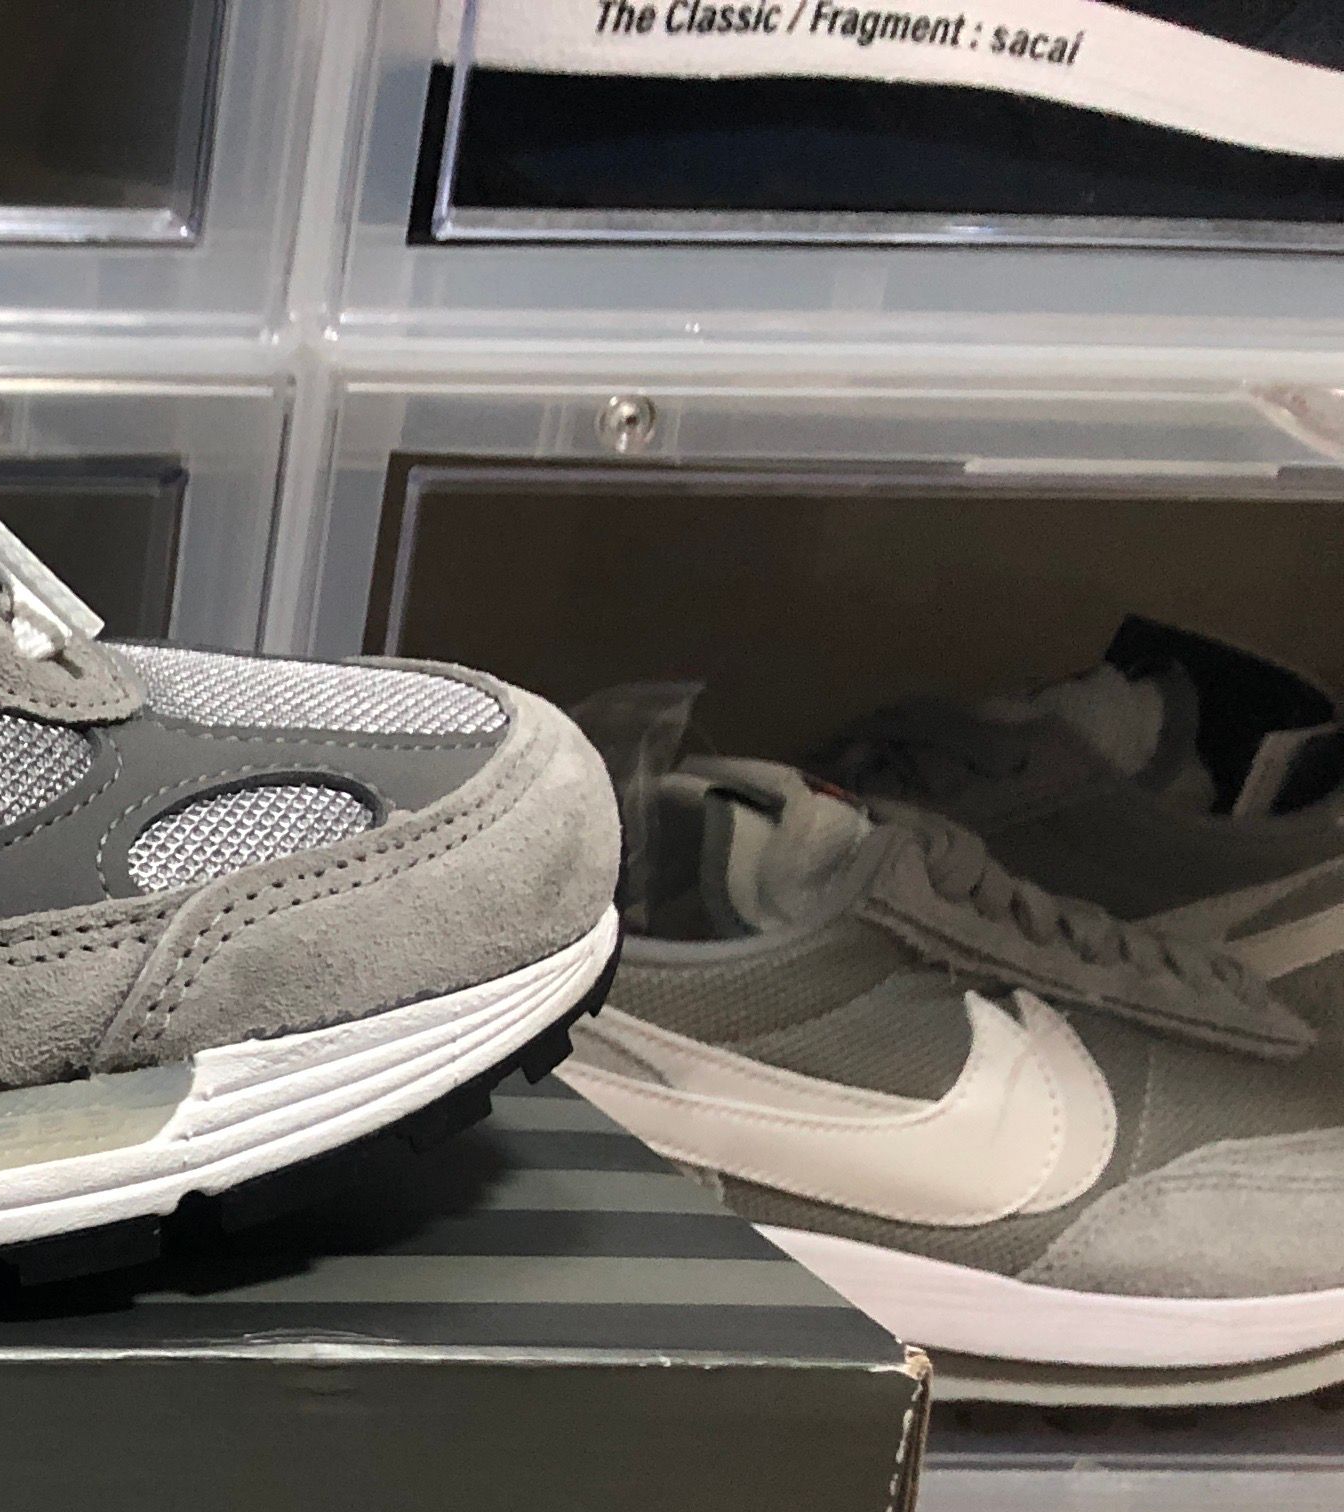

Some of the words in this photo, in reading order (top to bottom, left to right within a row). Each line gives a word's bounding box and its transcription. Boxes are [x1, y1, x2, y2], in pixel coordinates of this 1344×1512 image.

[595, 0, 656, 34] The
[665, 0, 782, 35] Classic
[809, 0, 966, 47] Fragment
[991, 24, 1086, 66] sacai
